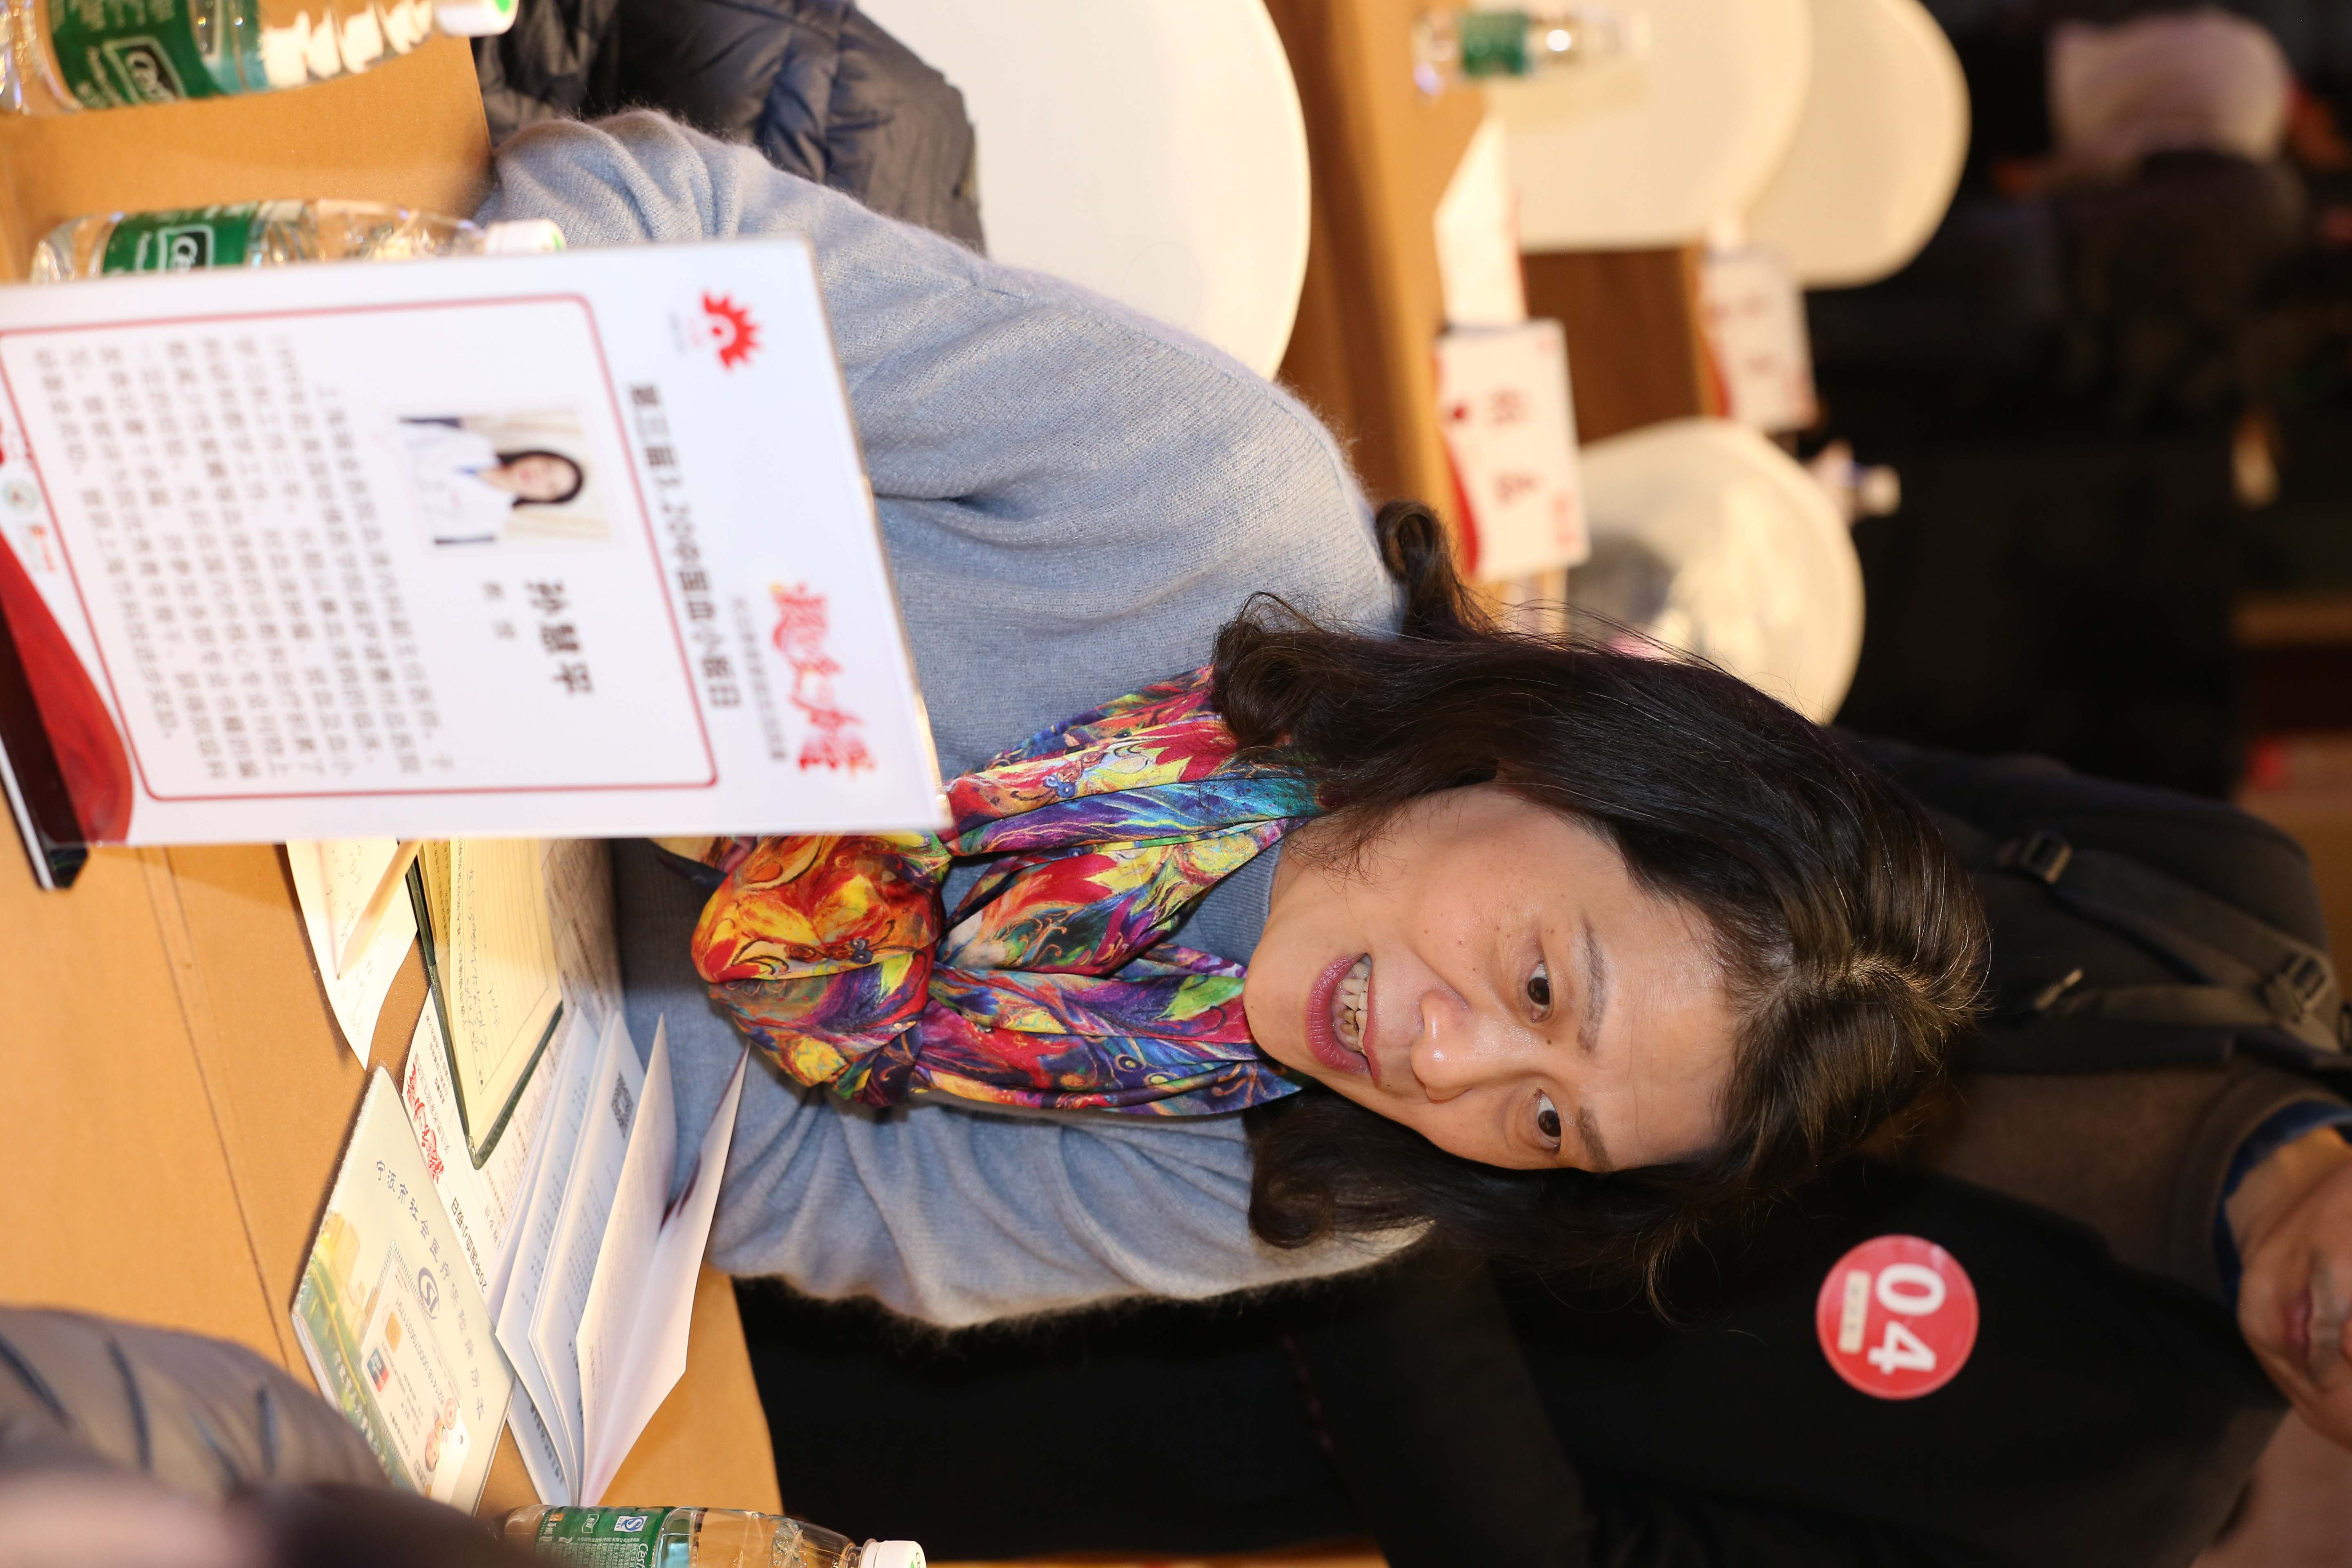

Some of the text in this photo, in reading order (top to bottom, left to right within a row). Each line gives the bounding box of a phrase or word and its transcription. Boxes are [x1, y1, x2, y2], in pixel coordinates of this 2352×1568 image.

[527, 581, 595, 695] 孙慧平
[414, 1051, 450, 1155] 关注患者家庭生活质量
[451, 1197, 487, 1294] 20中国血小板日
[1867, 1263, 1946, 1374] 04
